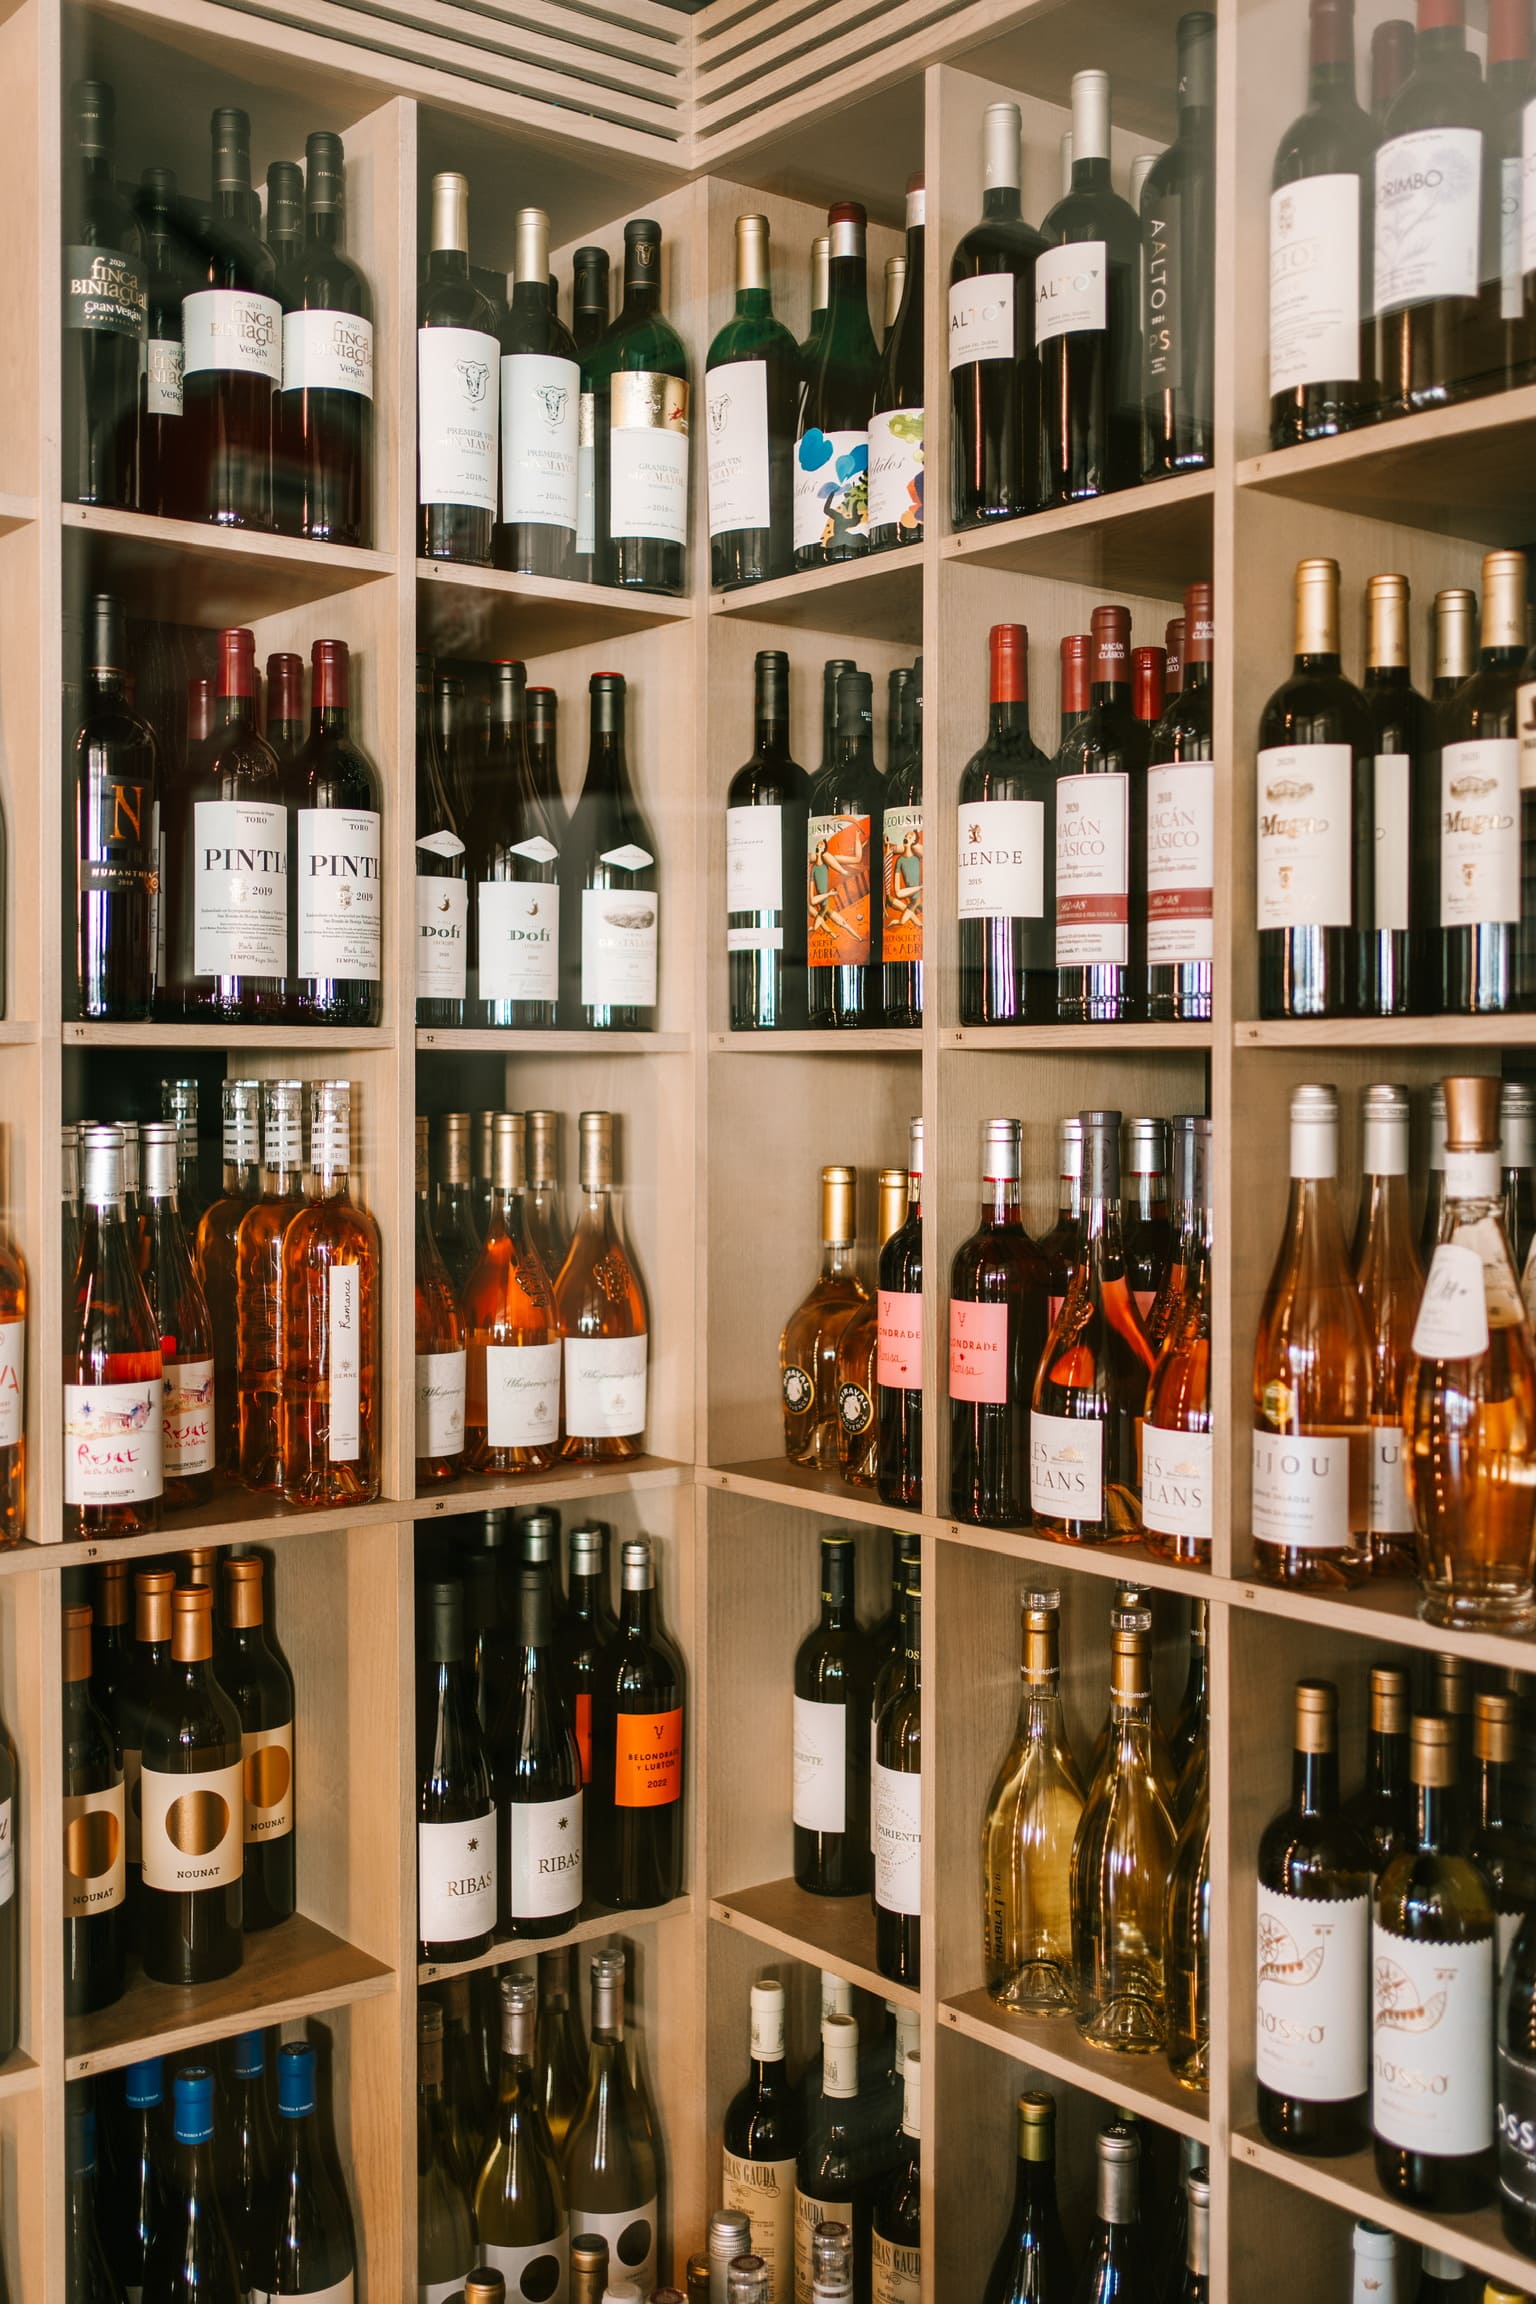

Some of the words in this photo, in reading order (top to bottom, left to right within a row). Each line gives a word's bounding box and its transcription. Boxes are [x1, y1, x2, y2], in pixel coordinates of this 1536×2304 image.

[109, 258, 126, 268] 2020
[1151, 220, 1167, 309] AALTO
[951, 304, 998, 332] ALTO
[110, 784, 144, 843] N
[245, 816, 267, 825] TORO
[350, 823, 369, 832] TORO
[1149, 830, 1201, 851] LÁSICO
[1058, 840, 1105, 859] LÁSICO
[968, 878, 983, 886] 2015
[252, 885, 273, 896] 2019
[356, 892, 374, 901] 2019
[74, 1028, 85, 1037] 11
[955, 1033, 963, 1041] 14
[426, 1034, 435, 1043] 12
[338, 1279, 351, 1330] Romance
[162, 1419, 208, 1441] Rosat
[77, 1443, 140, 1465] Rosat
[435, 1502, 444, 1511] 20
[951, 1526, 959, 1535] 22
[87, 1547, 97, 1557] 19
[1245, 1589, 1255, 1599] 23
[647, 1778, 668, 1789] 2022
[250, 1817, 286, 1832] NOUNAT
[538, 1849, 581, 1874] RIBAS
[177, 1867, 220, 1880] NOUNAT
[447, 1871, 493, 1897] RIBAS
[72, 1888, 114, 1905] NOUNAT
[428, 1966, 437, 1976] 28
[79, 2061, 89, 2070] 27
[1246, 2148, 1256, 2157] 31
[743, 2165, 776, 2188] GAUDA
